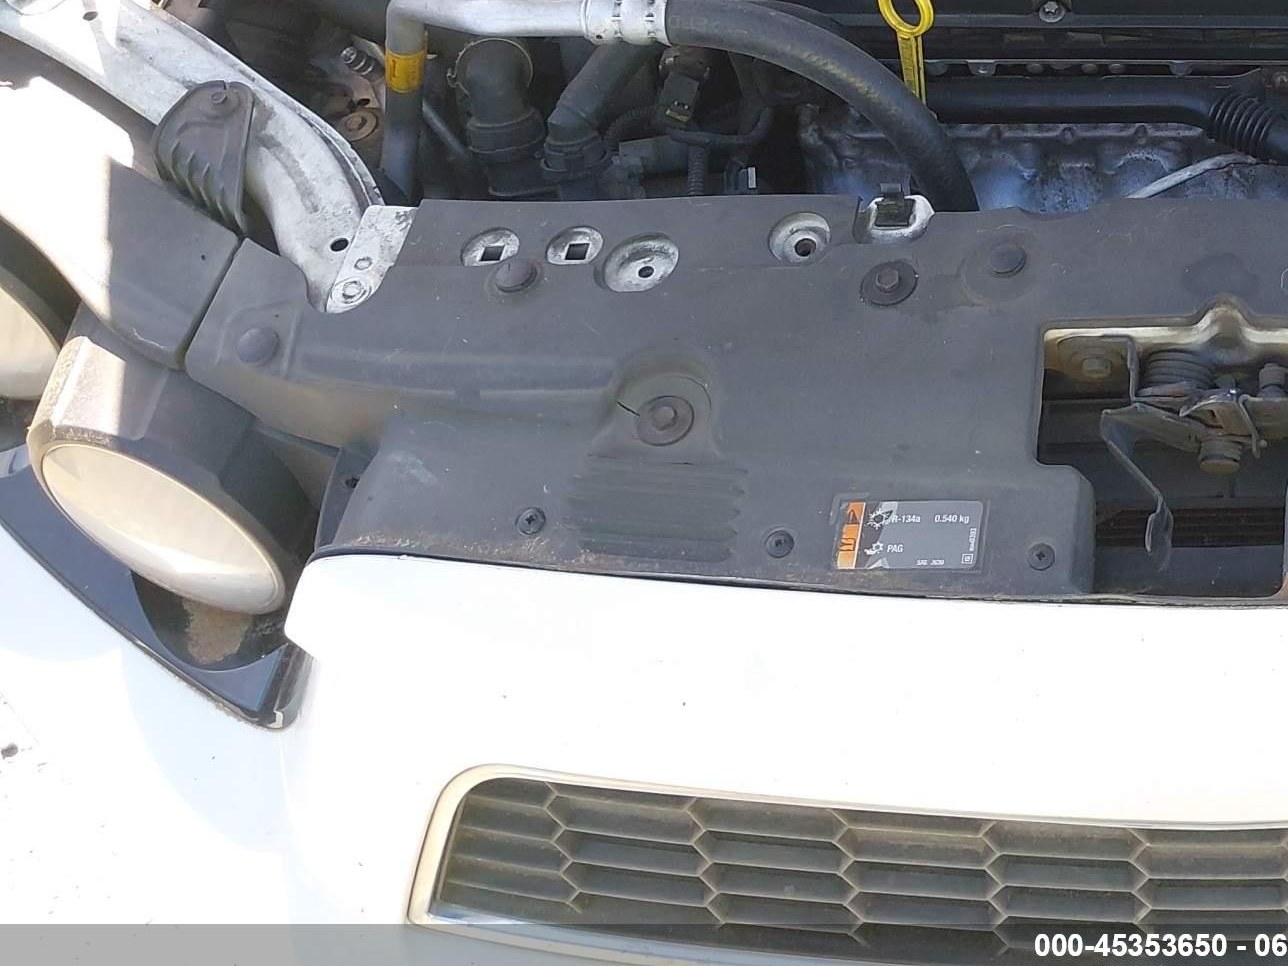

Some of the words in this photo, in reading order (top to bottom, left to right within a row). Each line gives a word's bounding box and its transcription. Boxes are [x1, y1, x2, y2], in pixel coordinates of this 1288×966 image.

[891, 514, 921, 523] R-134a
[934, 514, 957, 523] 0.540
[959, 514, 970, 524] kg
[886, 544, 904, 553] PAG
